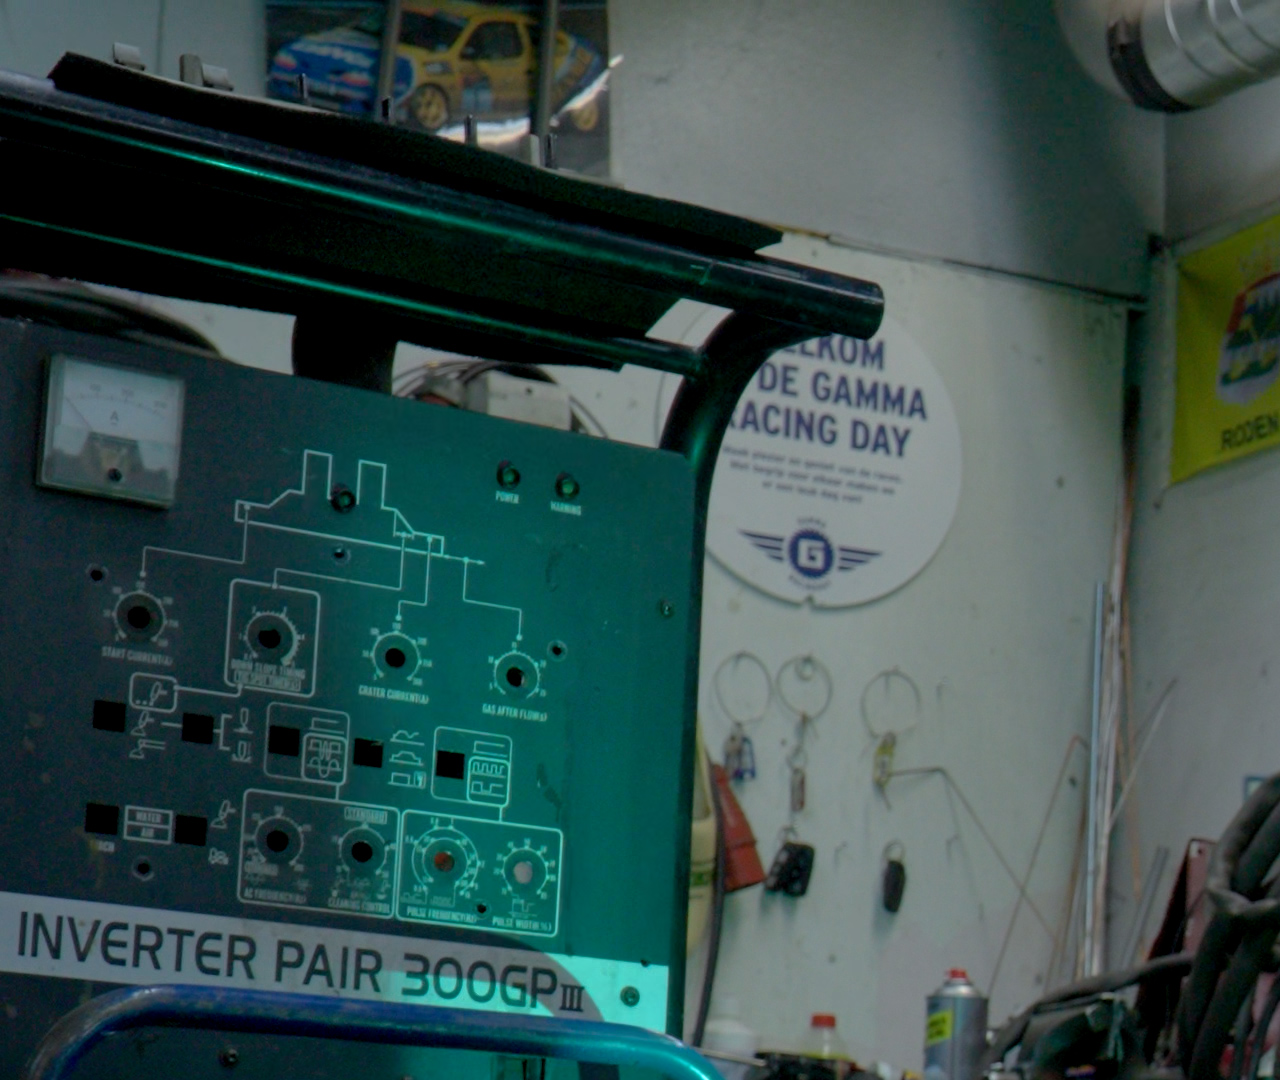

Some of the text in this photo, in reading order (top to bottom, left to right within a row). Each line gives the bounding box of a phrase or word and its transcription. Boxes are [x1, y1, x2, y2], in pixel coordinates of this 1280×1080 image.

[758, 361, 927, 420] DE GAMMA
[850, 418, 911, 457] DAY
[1221, 417, 1280, 451] RODEN
[358, 684, 385, 698] CRATER
[482, 703, 496, 715] GAS
[406, 905, 427, 917] PULSE
[492, 916, 513, 926] PULSE
[17, 909, 257, 982] INVERTER
[274, 943, 383, 995] PAIR
